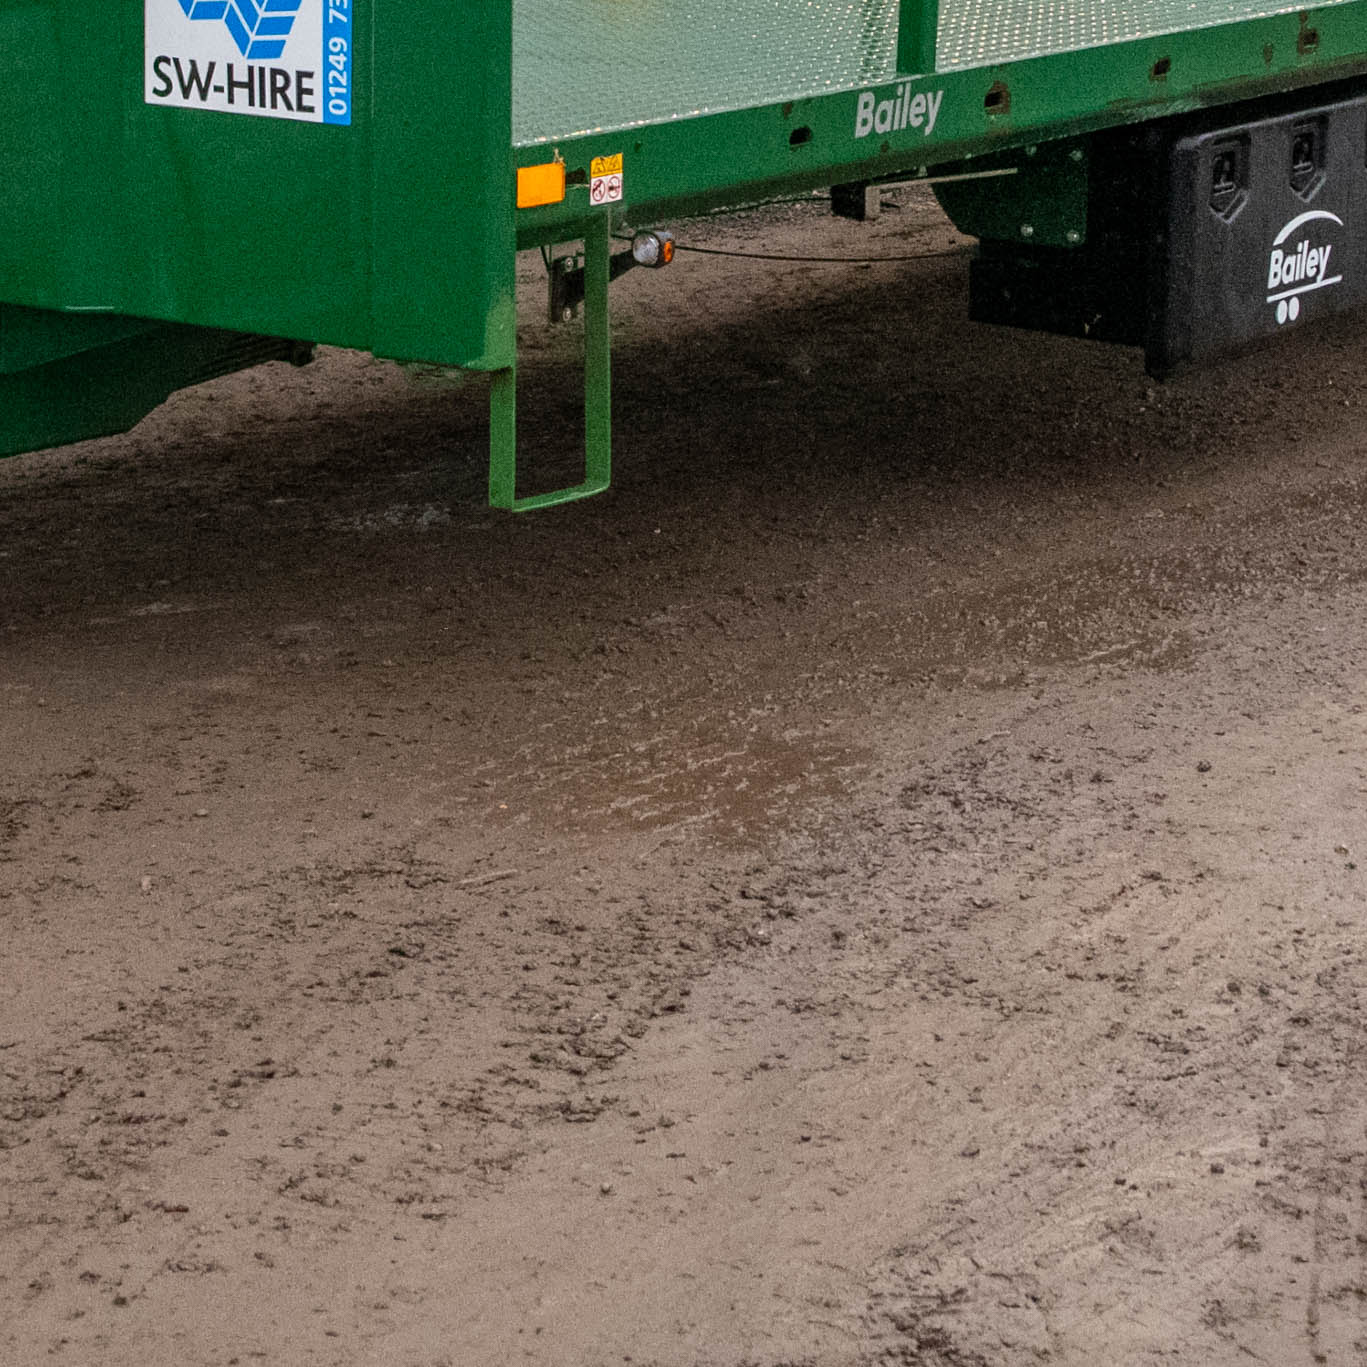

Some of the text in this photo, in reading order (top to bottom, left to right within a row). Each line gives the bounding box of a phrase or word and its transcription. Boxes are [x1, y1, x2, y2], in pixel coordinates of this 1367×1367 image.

[152, 55, 315, 114] SW-HIRE
[328, 37, 348, 116] 01249
[854, 82, 944, 138] Bailey
[1268, 239, 1332, 289] Bailey
